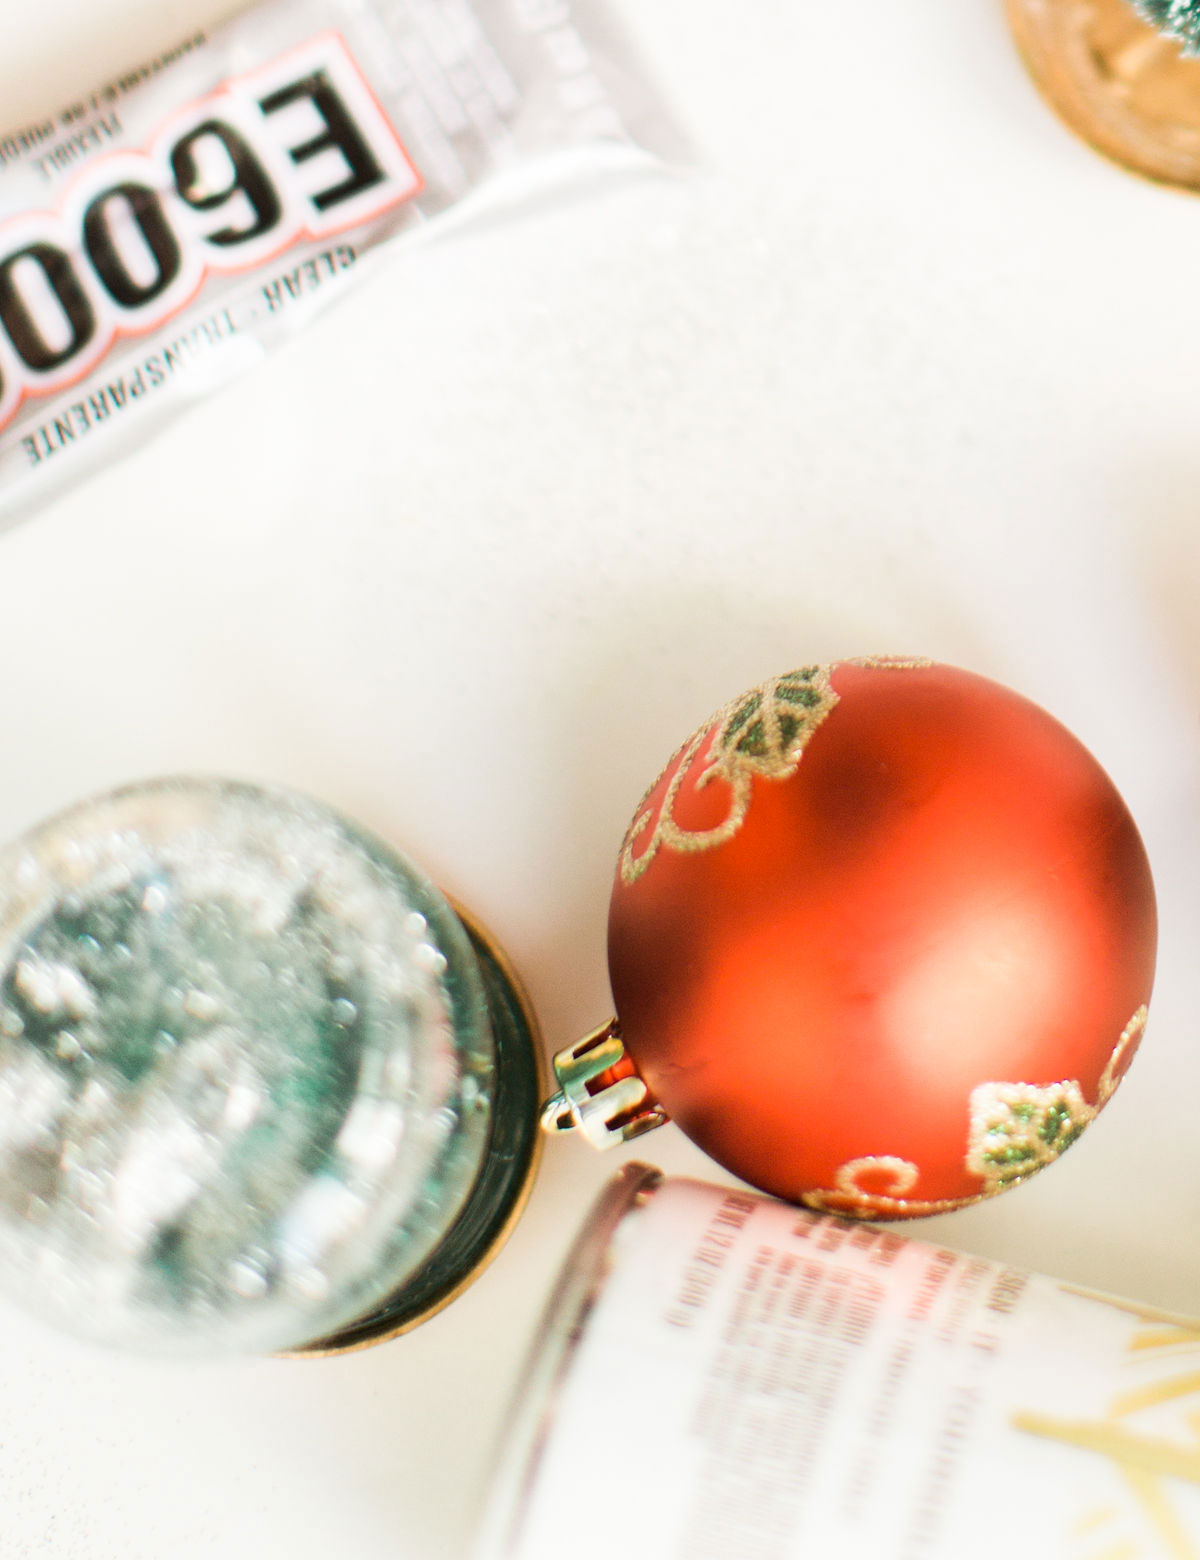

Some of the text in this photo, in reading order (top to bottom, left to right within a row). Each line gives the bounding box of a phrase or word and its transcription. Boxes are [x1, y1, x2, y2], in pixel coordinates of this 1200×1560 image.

[0, 68, 387, 400] E600
[22, 245, 357, 467] CLEAR TRANSPARENTE
